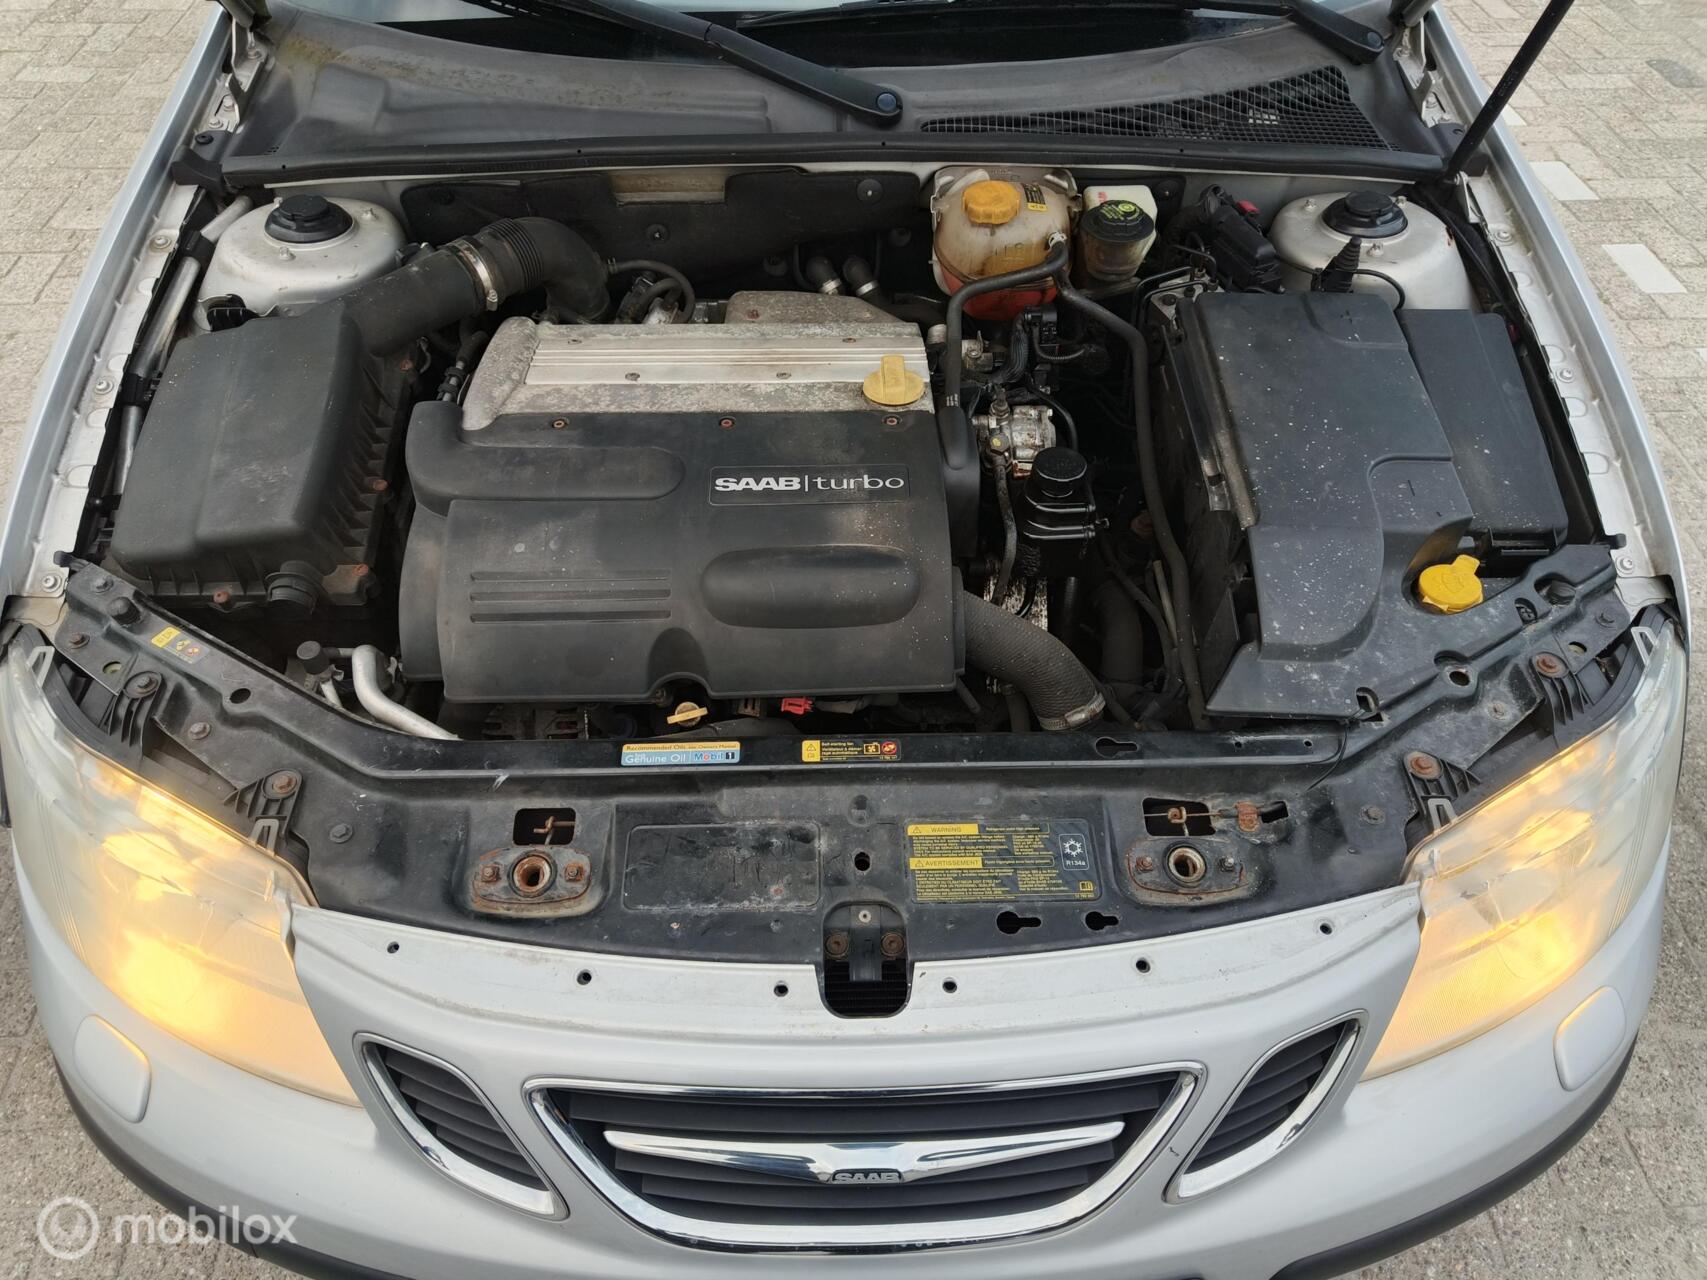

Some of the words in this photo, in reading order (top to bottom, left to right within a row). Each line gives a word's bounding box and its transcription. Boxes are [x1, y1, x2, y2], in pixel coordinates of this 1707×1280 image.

[715, 476, 801, 491] SAAB
[812, 474, 905, 490] turbo
[625, 754, 667, 764] Genuine
[670, 753, 686, 763] Oil
[694, 752, 724, 761] Mobil
[834, 1172, 899, 1184] SAAB
